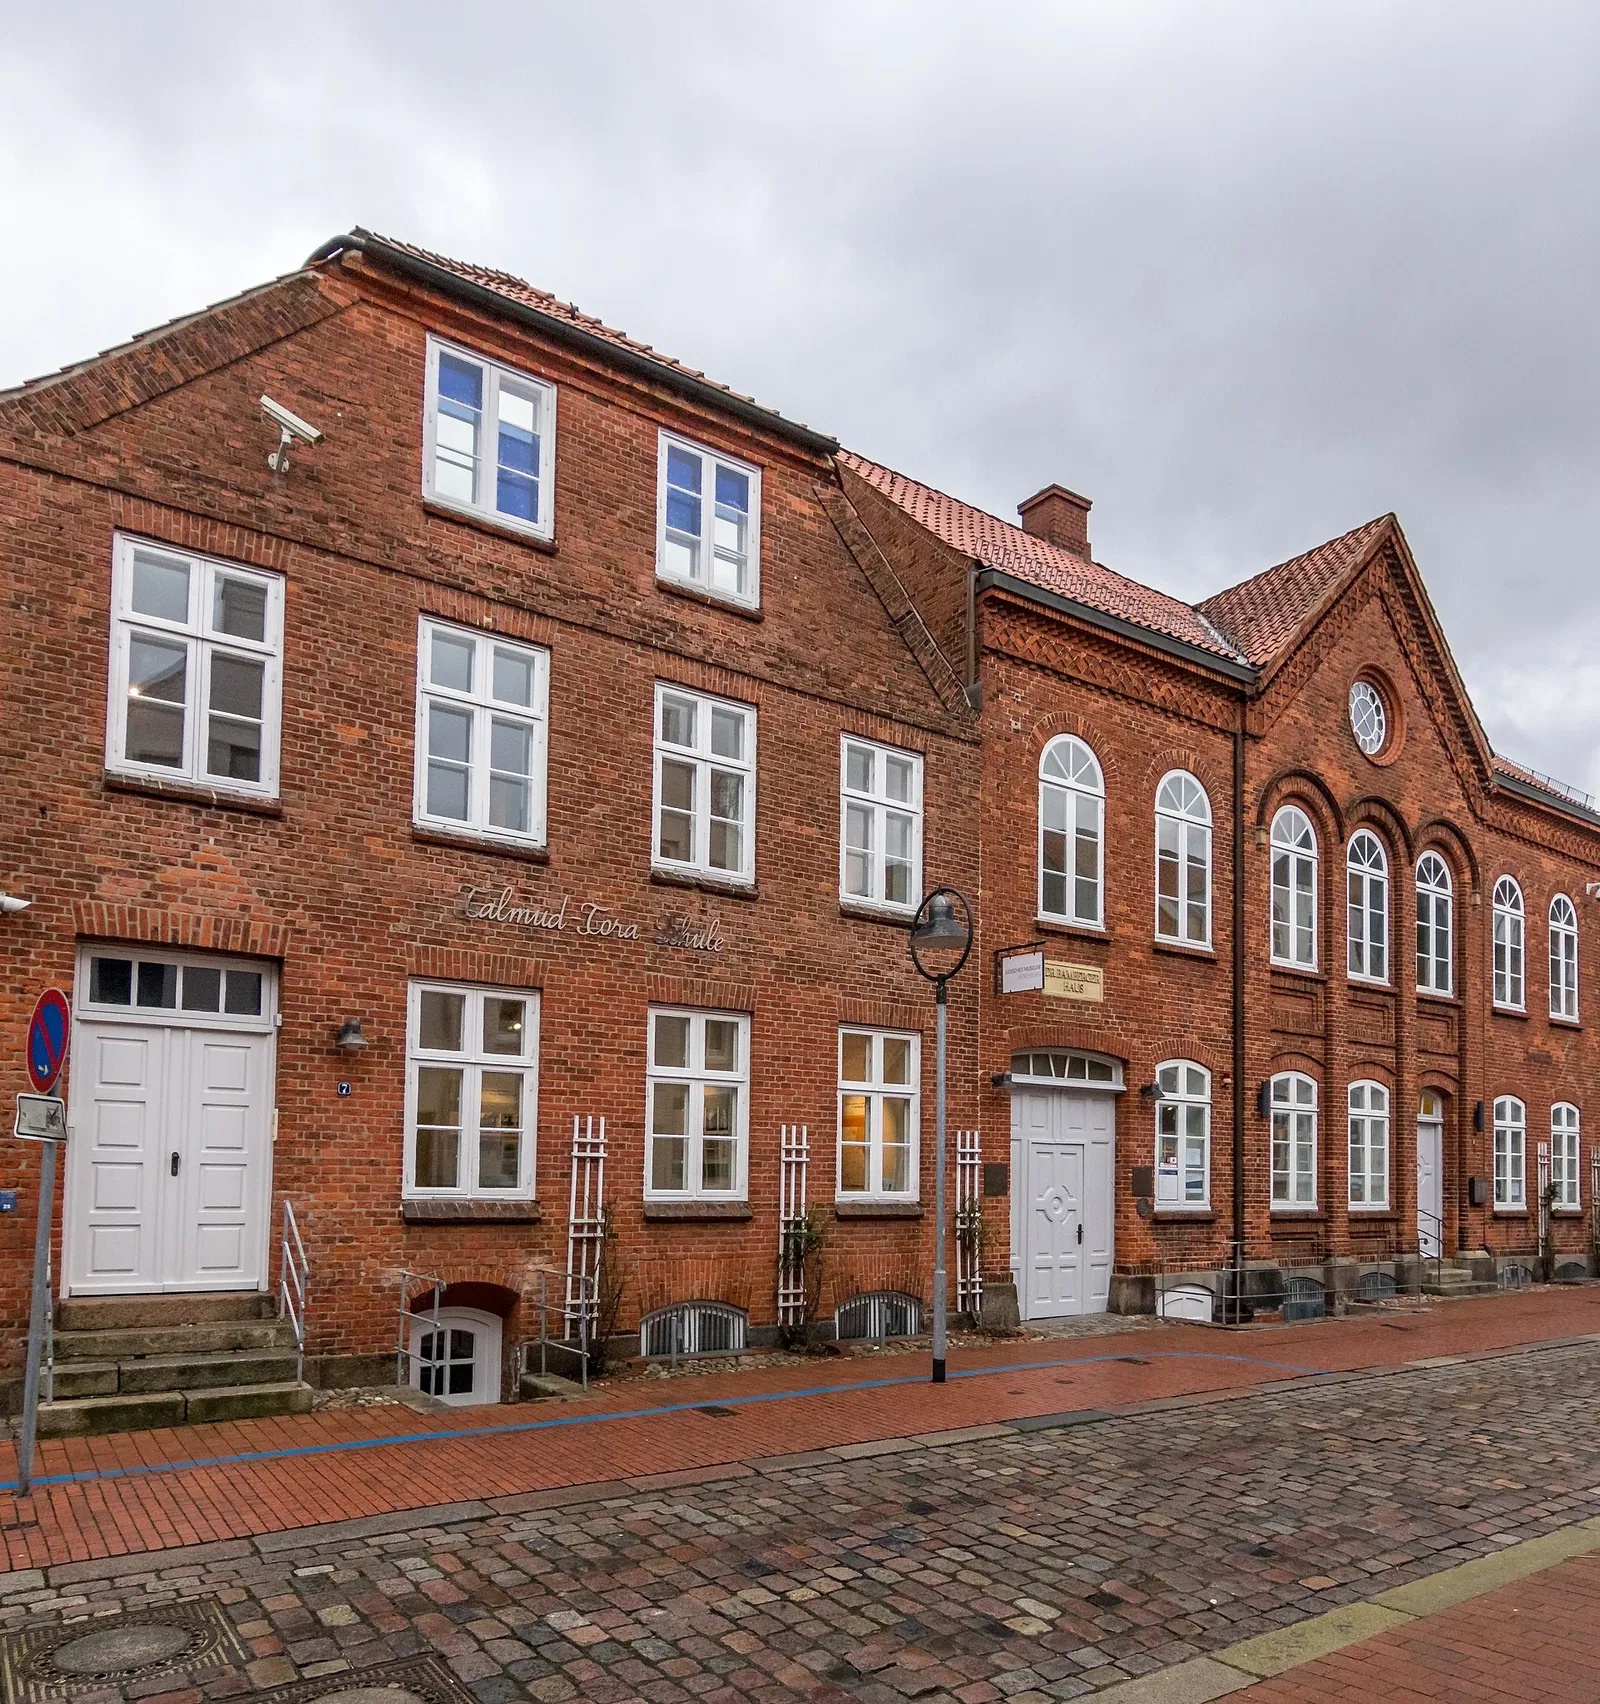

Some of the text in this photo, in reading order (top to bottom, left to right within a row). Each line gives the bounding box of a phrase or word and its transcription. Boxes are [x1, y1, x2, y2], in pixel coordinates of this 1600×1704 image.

[1056, 968, 1100, 984] BAMBERGER
[1062, 981, 1084, 993] HAUS
[341, 1084, 348, 1094] 7
